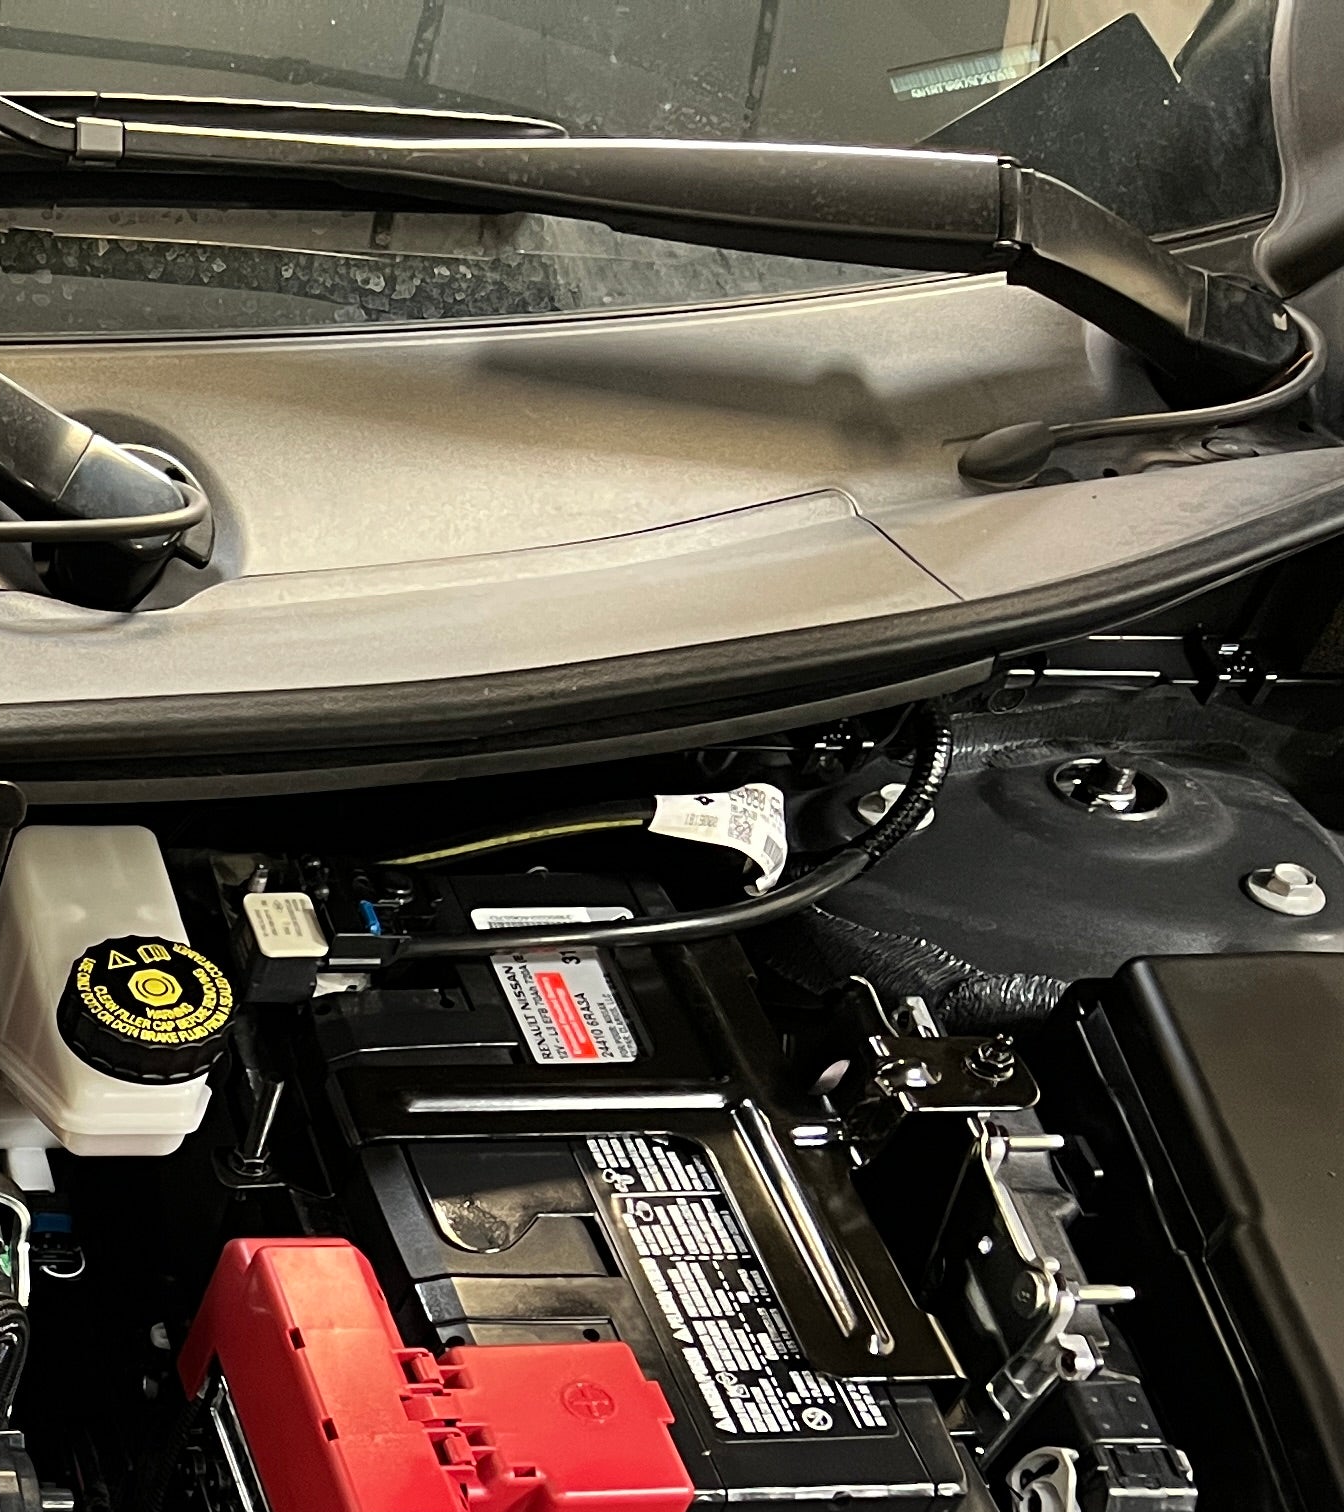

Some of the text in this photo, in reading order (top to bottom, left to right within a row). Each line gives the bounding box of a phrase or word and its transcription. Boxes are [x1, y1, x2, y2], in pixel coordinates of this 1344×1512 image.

[560, 950, 581, 964] 31
[93, 985, 116, 1015] CLEAN
[113, 1008, 152, 1030] FILLER
[152, 1020, 176, 1032] CAP
[174, 1005, 213, 1030] BEFORE
[145, 1002, 195, 1020] WARNING
[502, 966, 553, 1059] RENAULT NISSAN
[97, 1009, 115, 1025] OR
[110, 1020, 139, 1038] DOT4
[140, 1029, 179, 1043] BRAKE
[178, 1027, 209, 1043] FLUID
[591, 1029, 614, 1057] 24410
